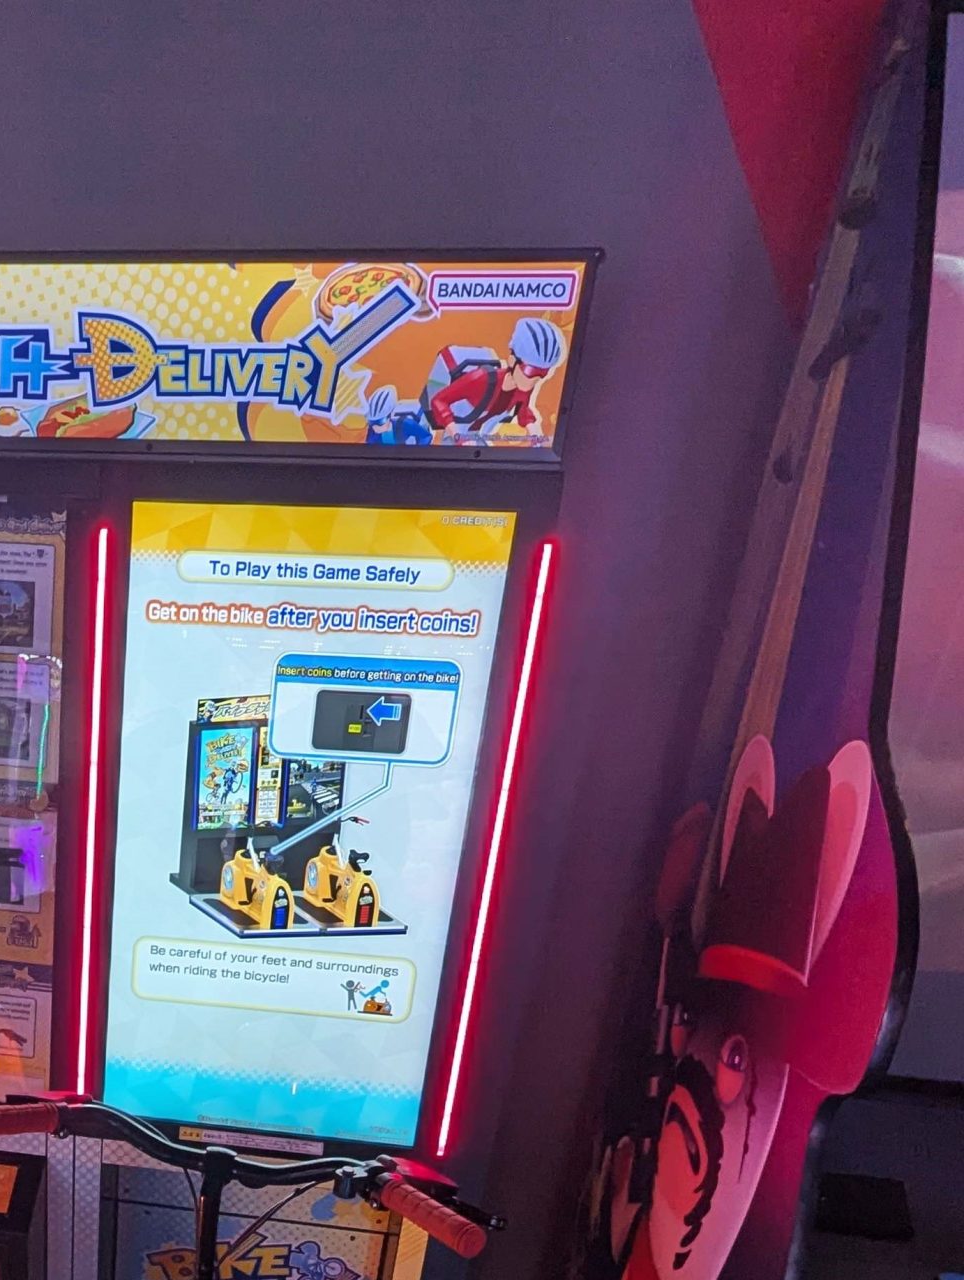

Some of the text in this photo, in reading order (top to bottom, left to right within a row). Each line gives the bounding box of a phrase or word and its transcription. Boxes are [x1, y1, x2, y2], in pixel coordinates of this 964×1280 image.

[438, 281, 567, 299] BANDAI NAMCO
[72, 281, 415, 411] DELIVERY
[209, 560, 421, 585] To Play this Game Safely
[148, 602, 478, 633] Get on the bike after you insert coins!
[278, 665, 459, 684] Insert coins before getting on the bike!
[149, 962, 290, 984] when riding the bicycle!
[150, 945, 399, 977] Be careful of your feet and surroundings
